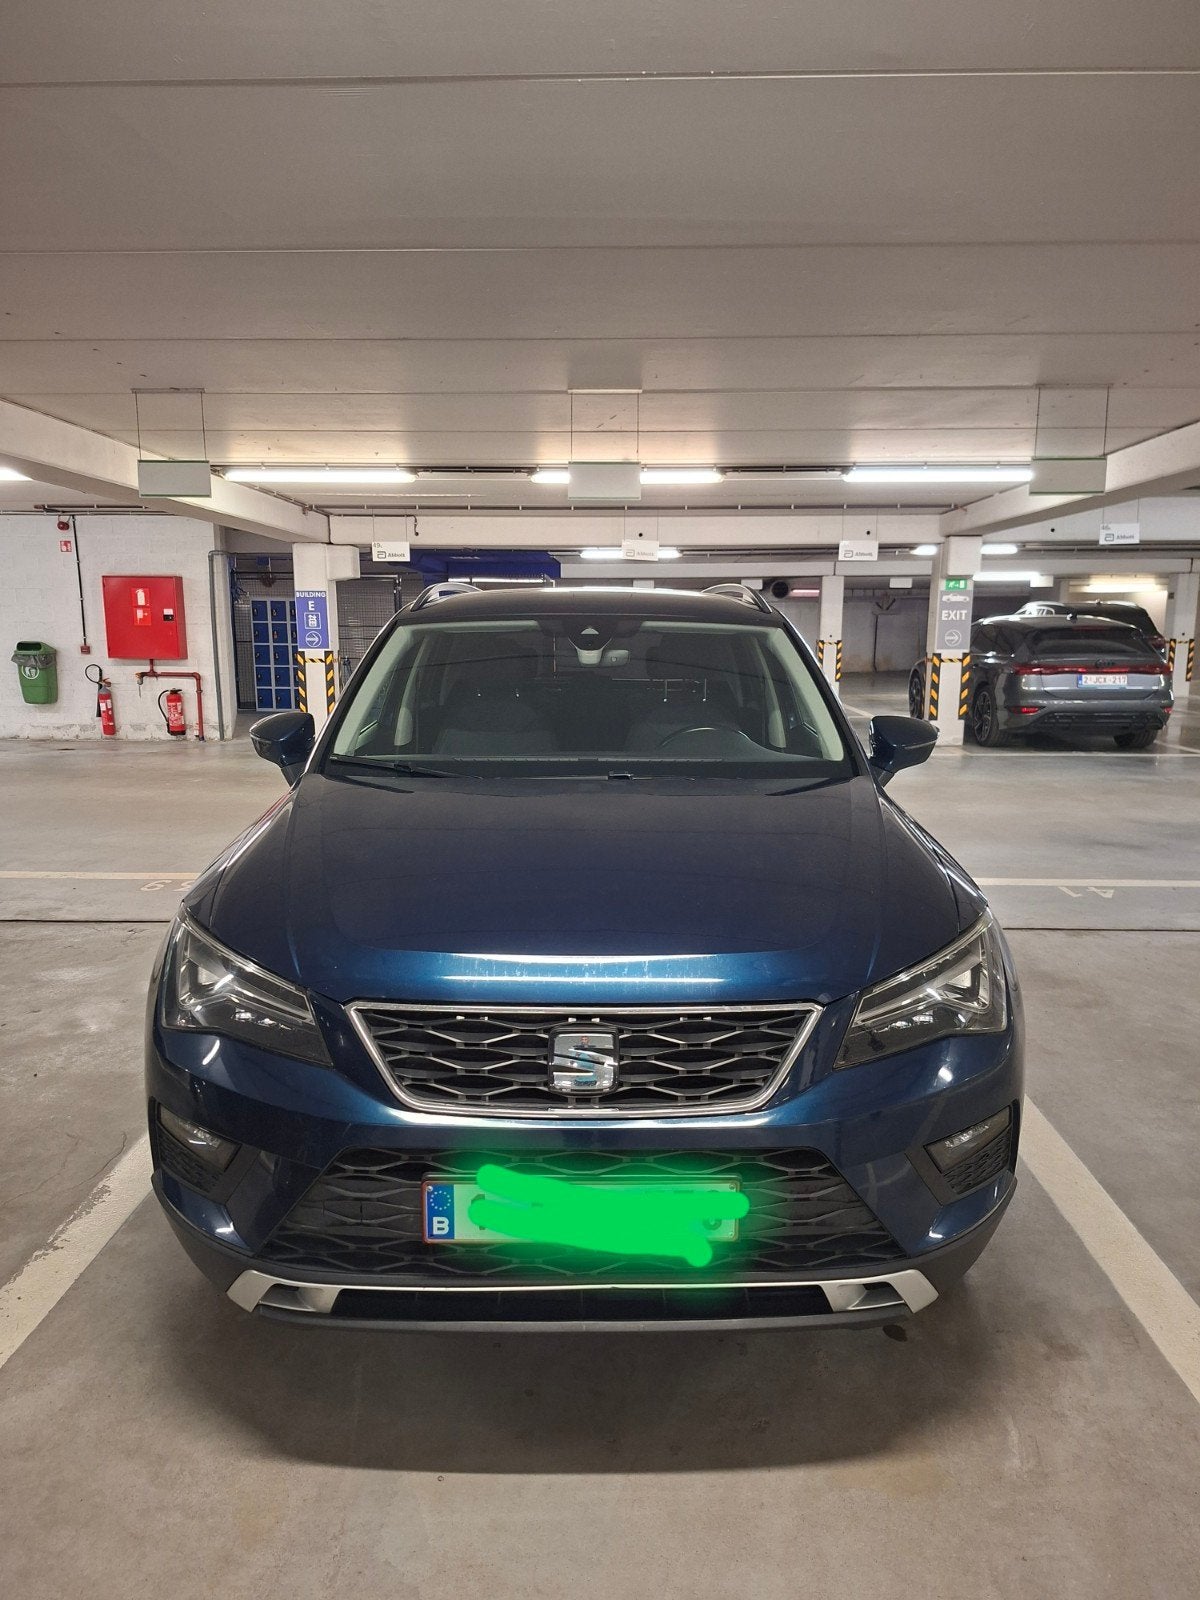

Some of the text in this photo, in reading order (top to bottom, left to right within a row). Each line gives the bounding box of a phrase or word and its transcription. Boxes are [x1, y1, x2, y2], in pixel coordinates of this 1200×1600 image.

[308, 600, 315, 611] E
[941, 610, 967, 621] EXIT
[432, 1216, 450, 1235] B
